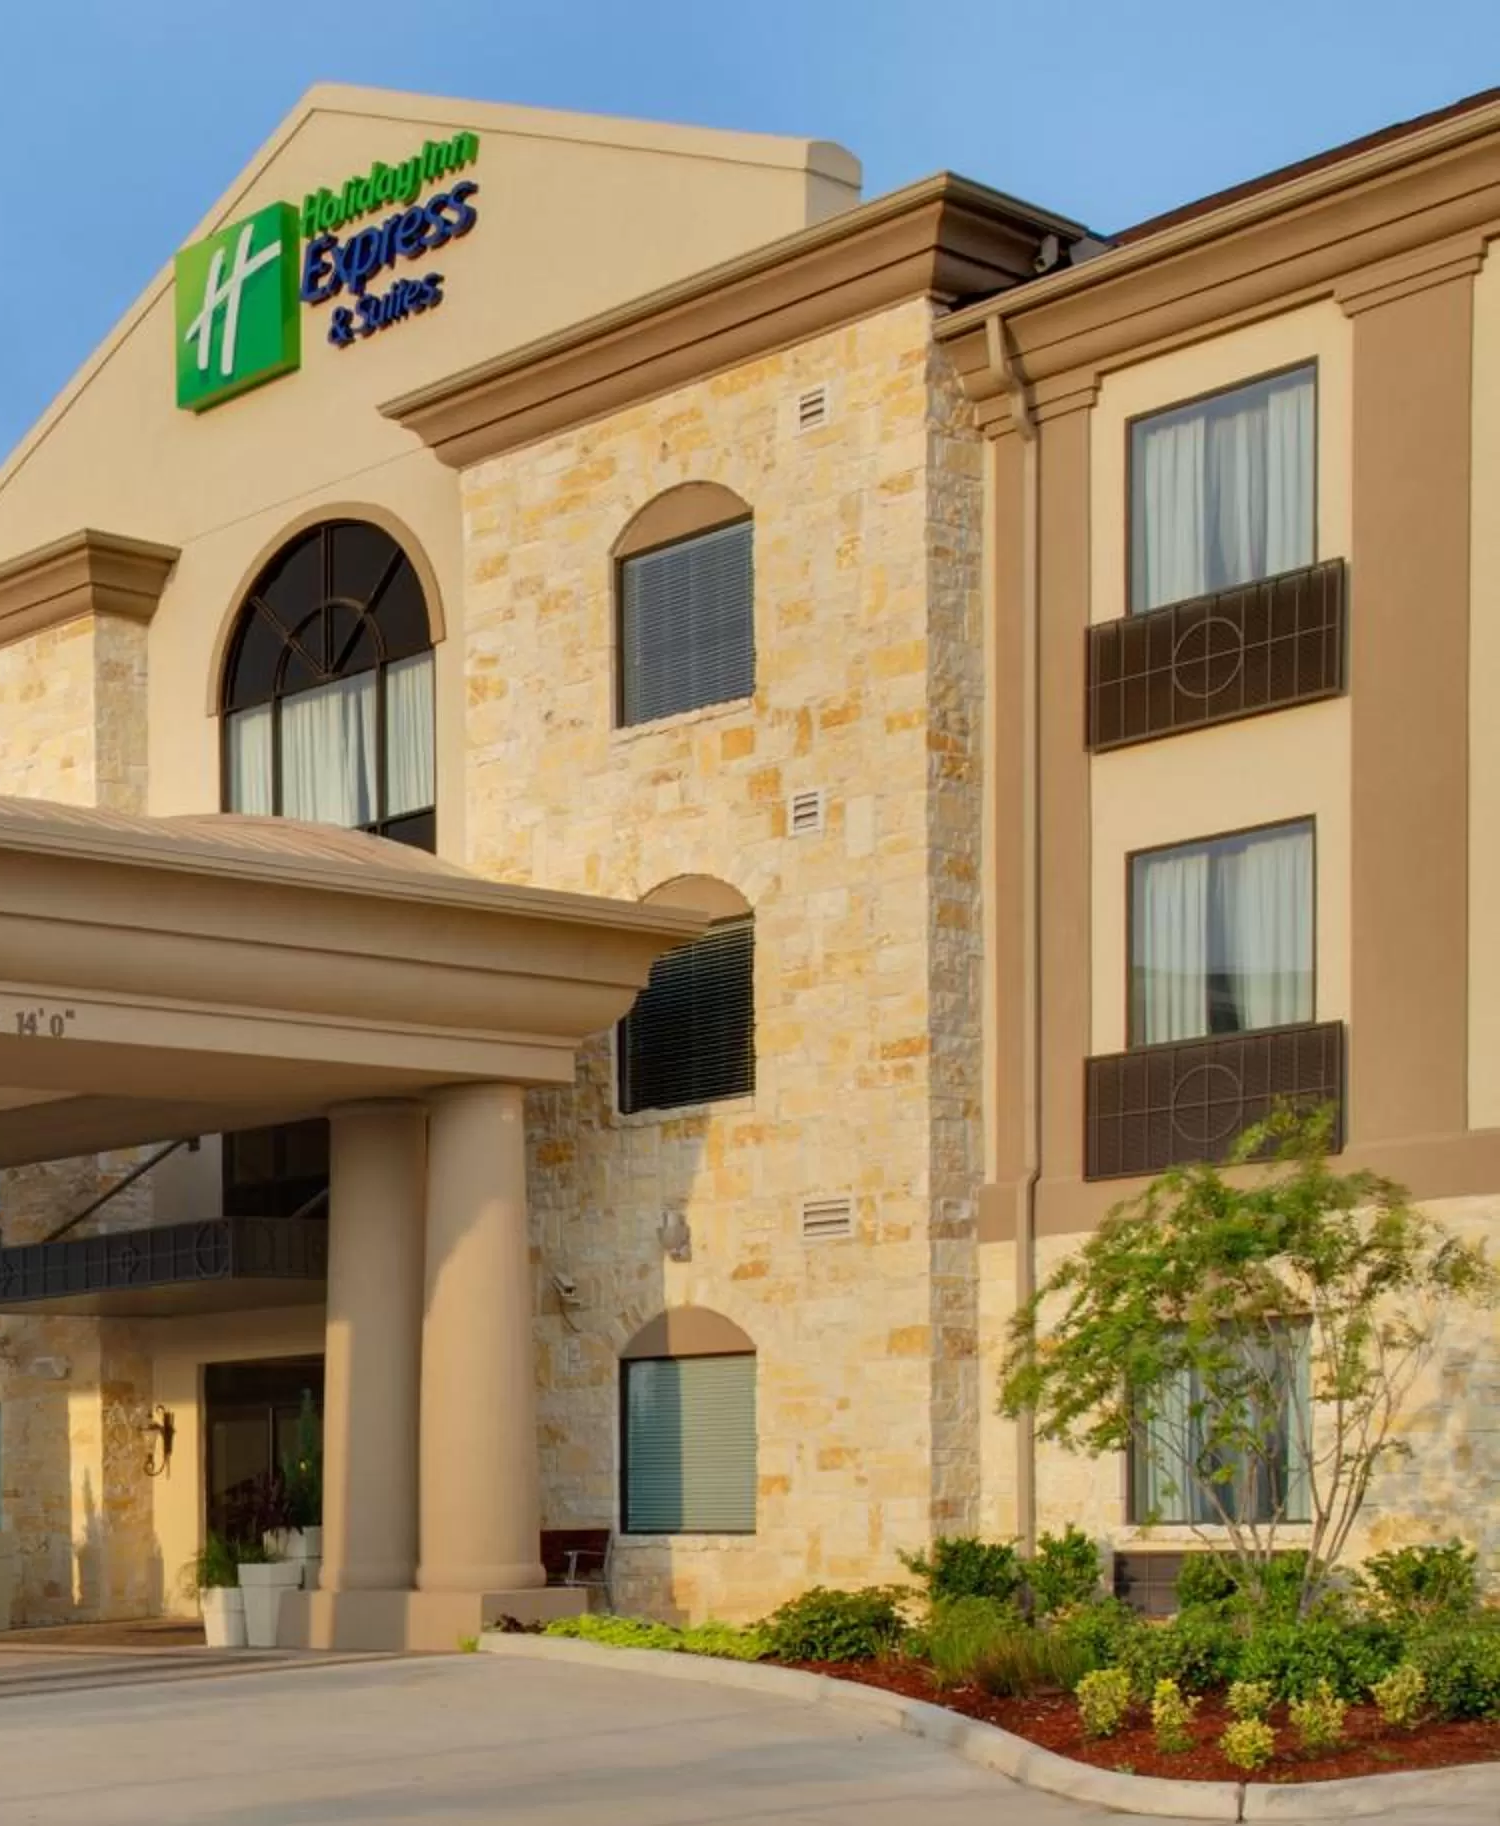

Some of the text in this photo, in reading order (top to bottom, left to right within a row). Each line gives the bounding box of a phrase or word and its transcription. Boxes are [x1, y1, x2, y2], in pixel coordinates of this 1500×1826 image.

[301, 132, 479, 239] Holiday Inn
[301, 181, 479, 307] Express
[328, 273, 445, 349] & Suites
